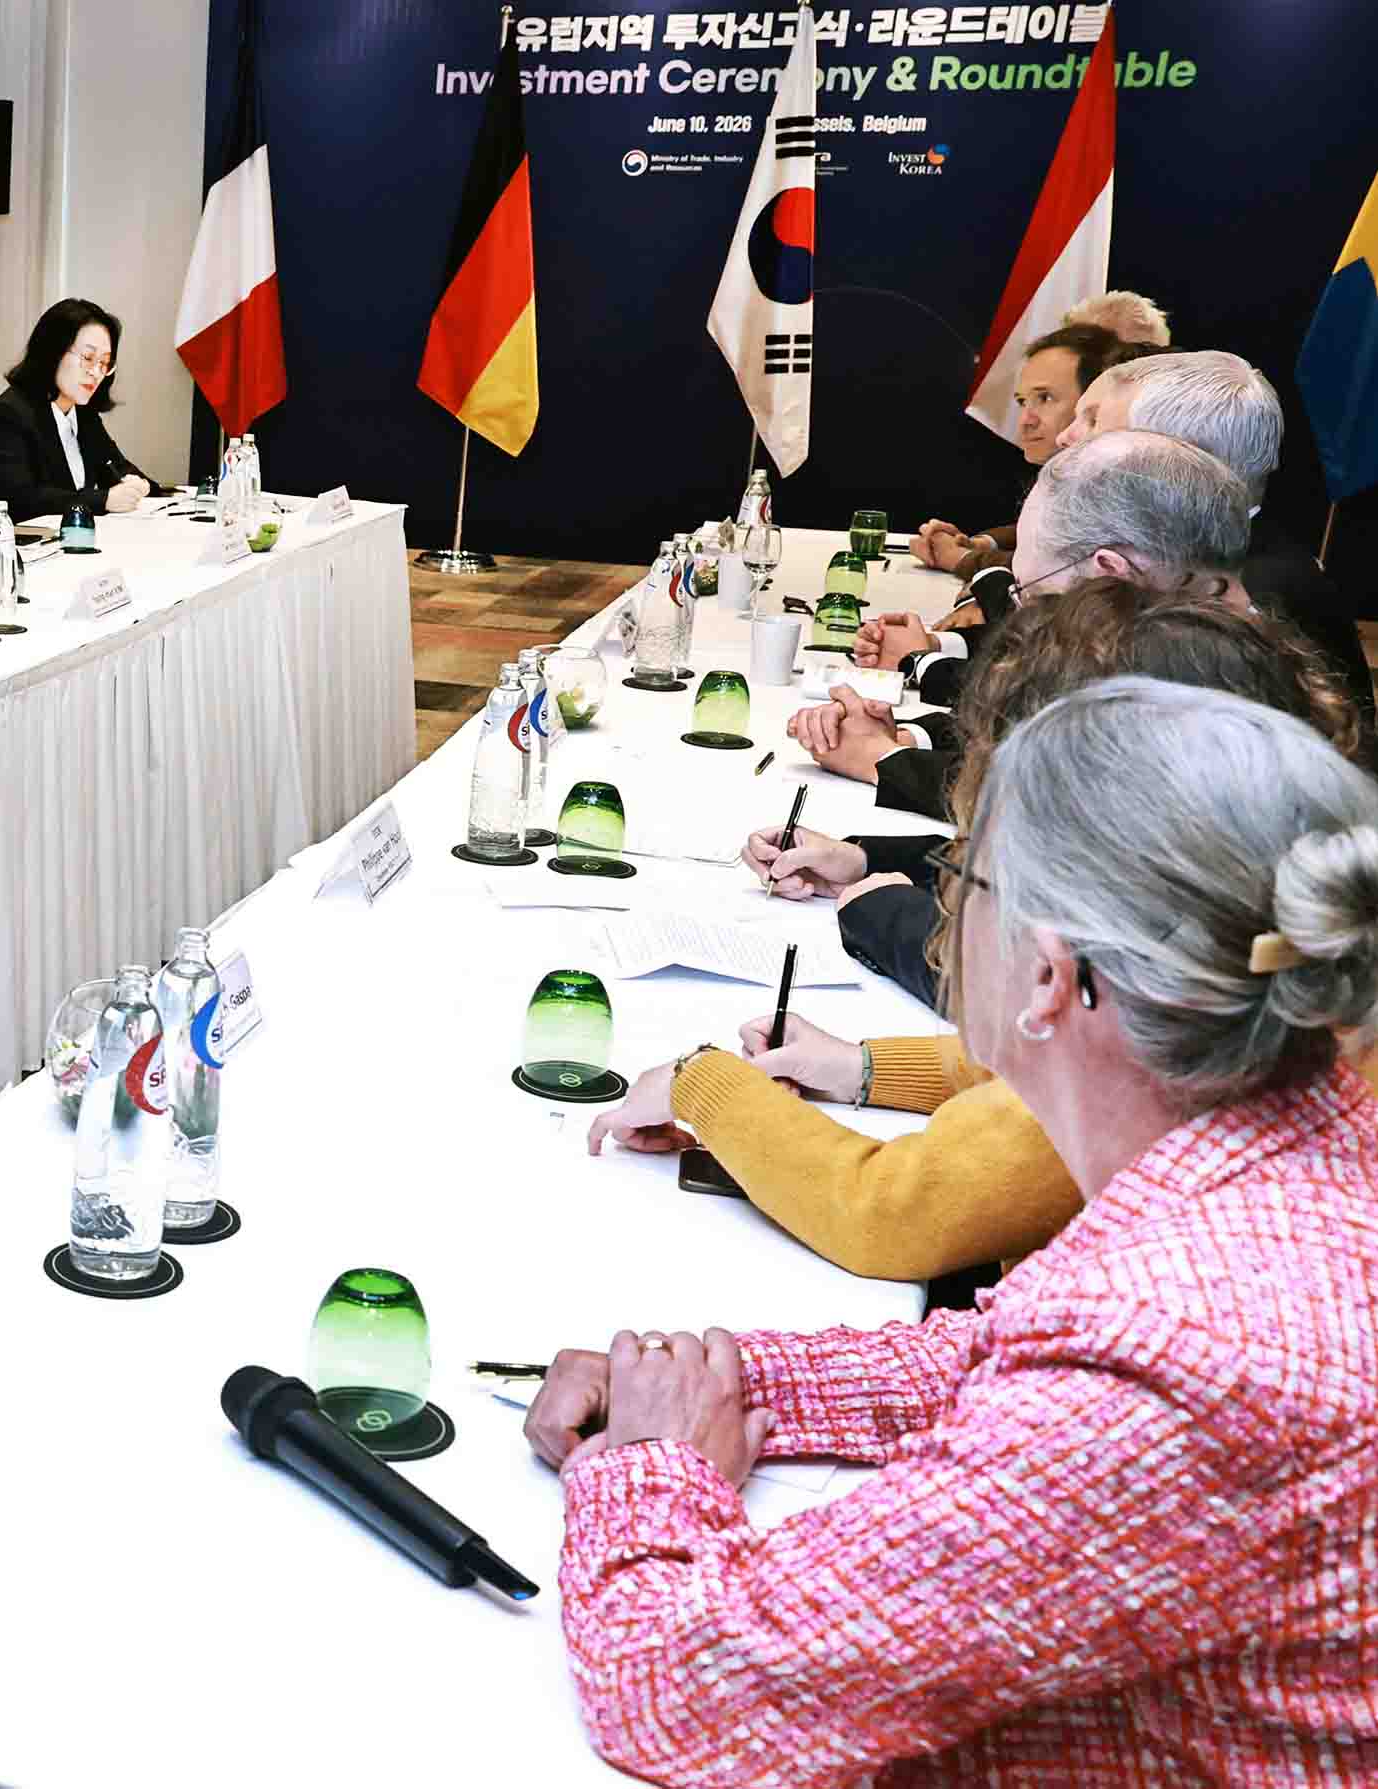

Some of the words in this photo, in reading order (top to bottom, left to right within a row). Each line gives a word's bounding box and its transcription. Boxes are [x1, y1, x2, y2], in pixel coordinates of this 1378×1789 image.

[516, 15, 654, 52] 유럽지역
[435, 62, 650, 95] Invstment
[659, 59, 877, 100] Ceremny
[885, 56, 918, 92] &
[929, 50, 1197, 91] Roundtble
[647, 116, 686, 133] June
[714, 115, 752, 133] 2026
[862, 115, 927, 134] Belgium
[899, 162, 943, 175] KOREA
